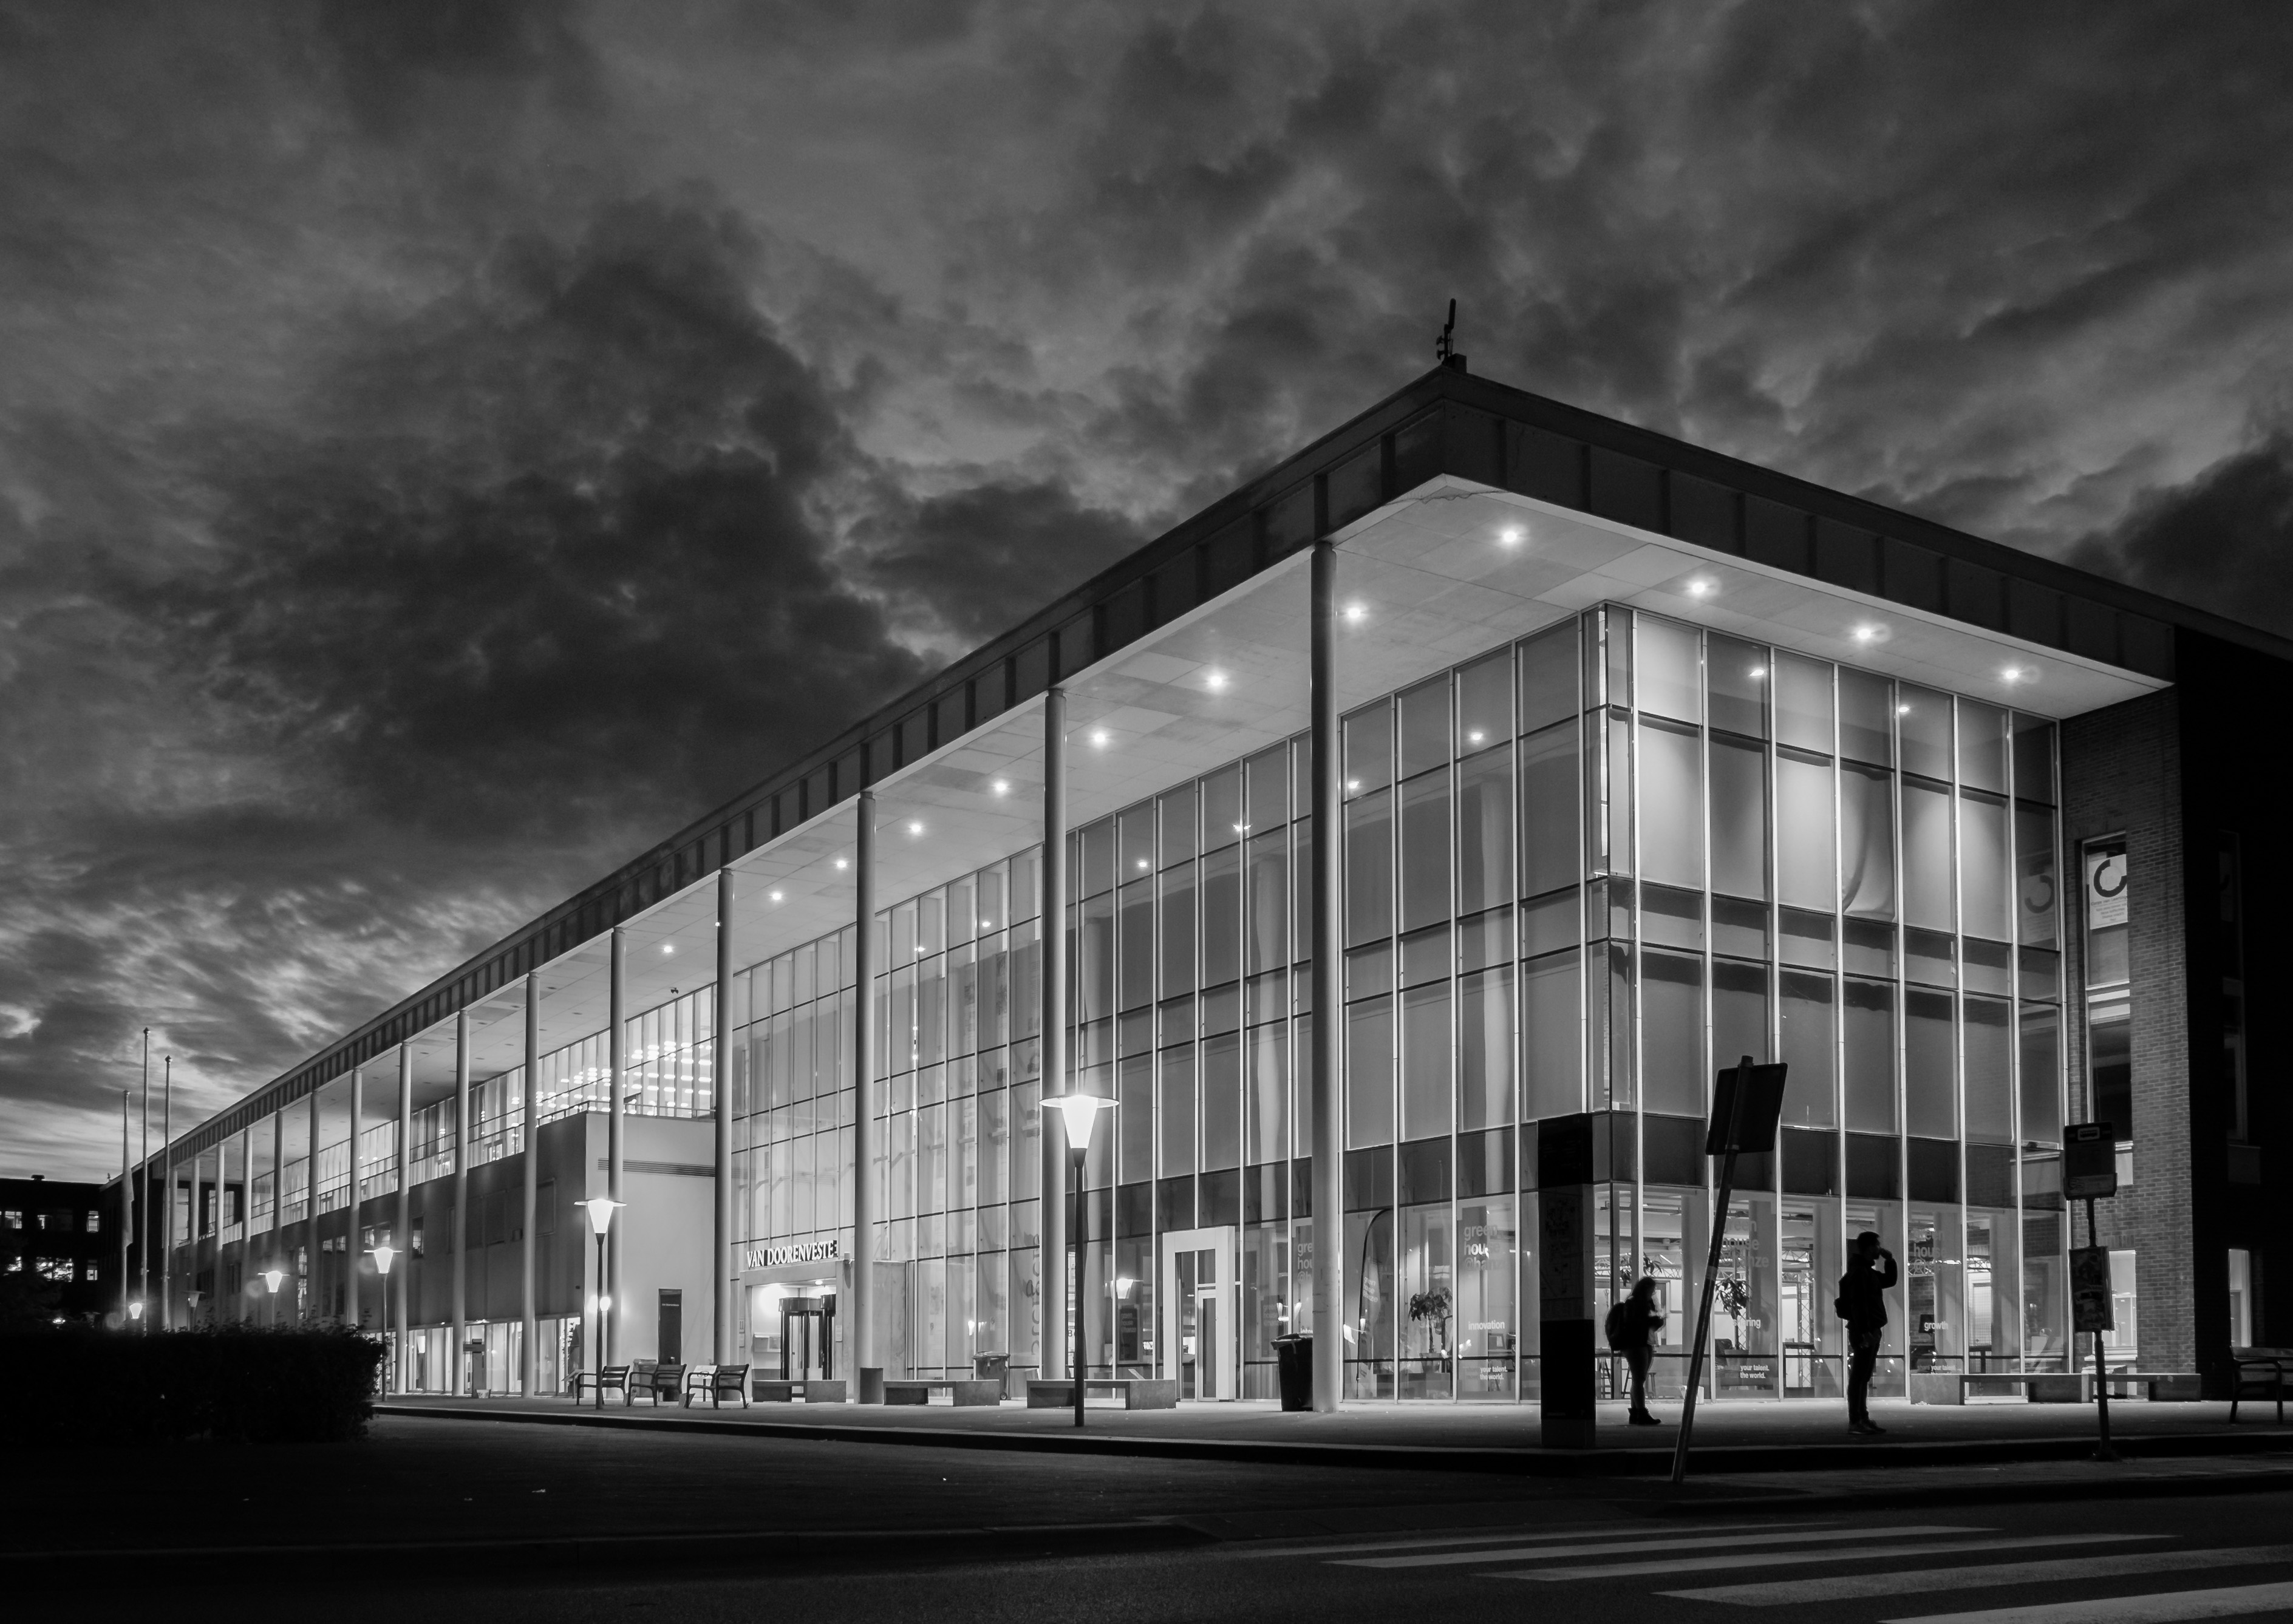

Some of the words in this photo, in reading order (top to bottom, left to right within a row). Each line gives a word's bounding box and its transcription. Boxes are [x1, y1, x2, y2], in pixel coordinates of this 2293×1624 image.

[1464, 1225, 1497, 1241] green
[746, 1249, 765, 1268] VAN
[767, 1240, 835, 1266] DOORENVESTE
[1914, 1243, 1948, 1257] house
[1468, 1320, 1505, 1330] innovation
[1924, 1321, 1949, 1331] growth
